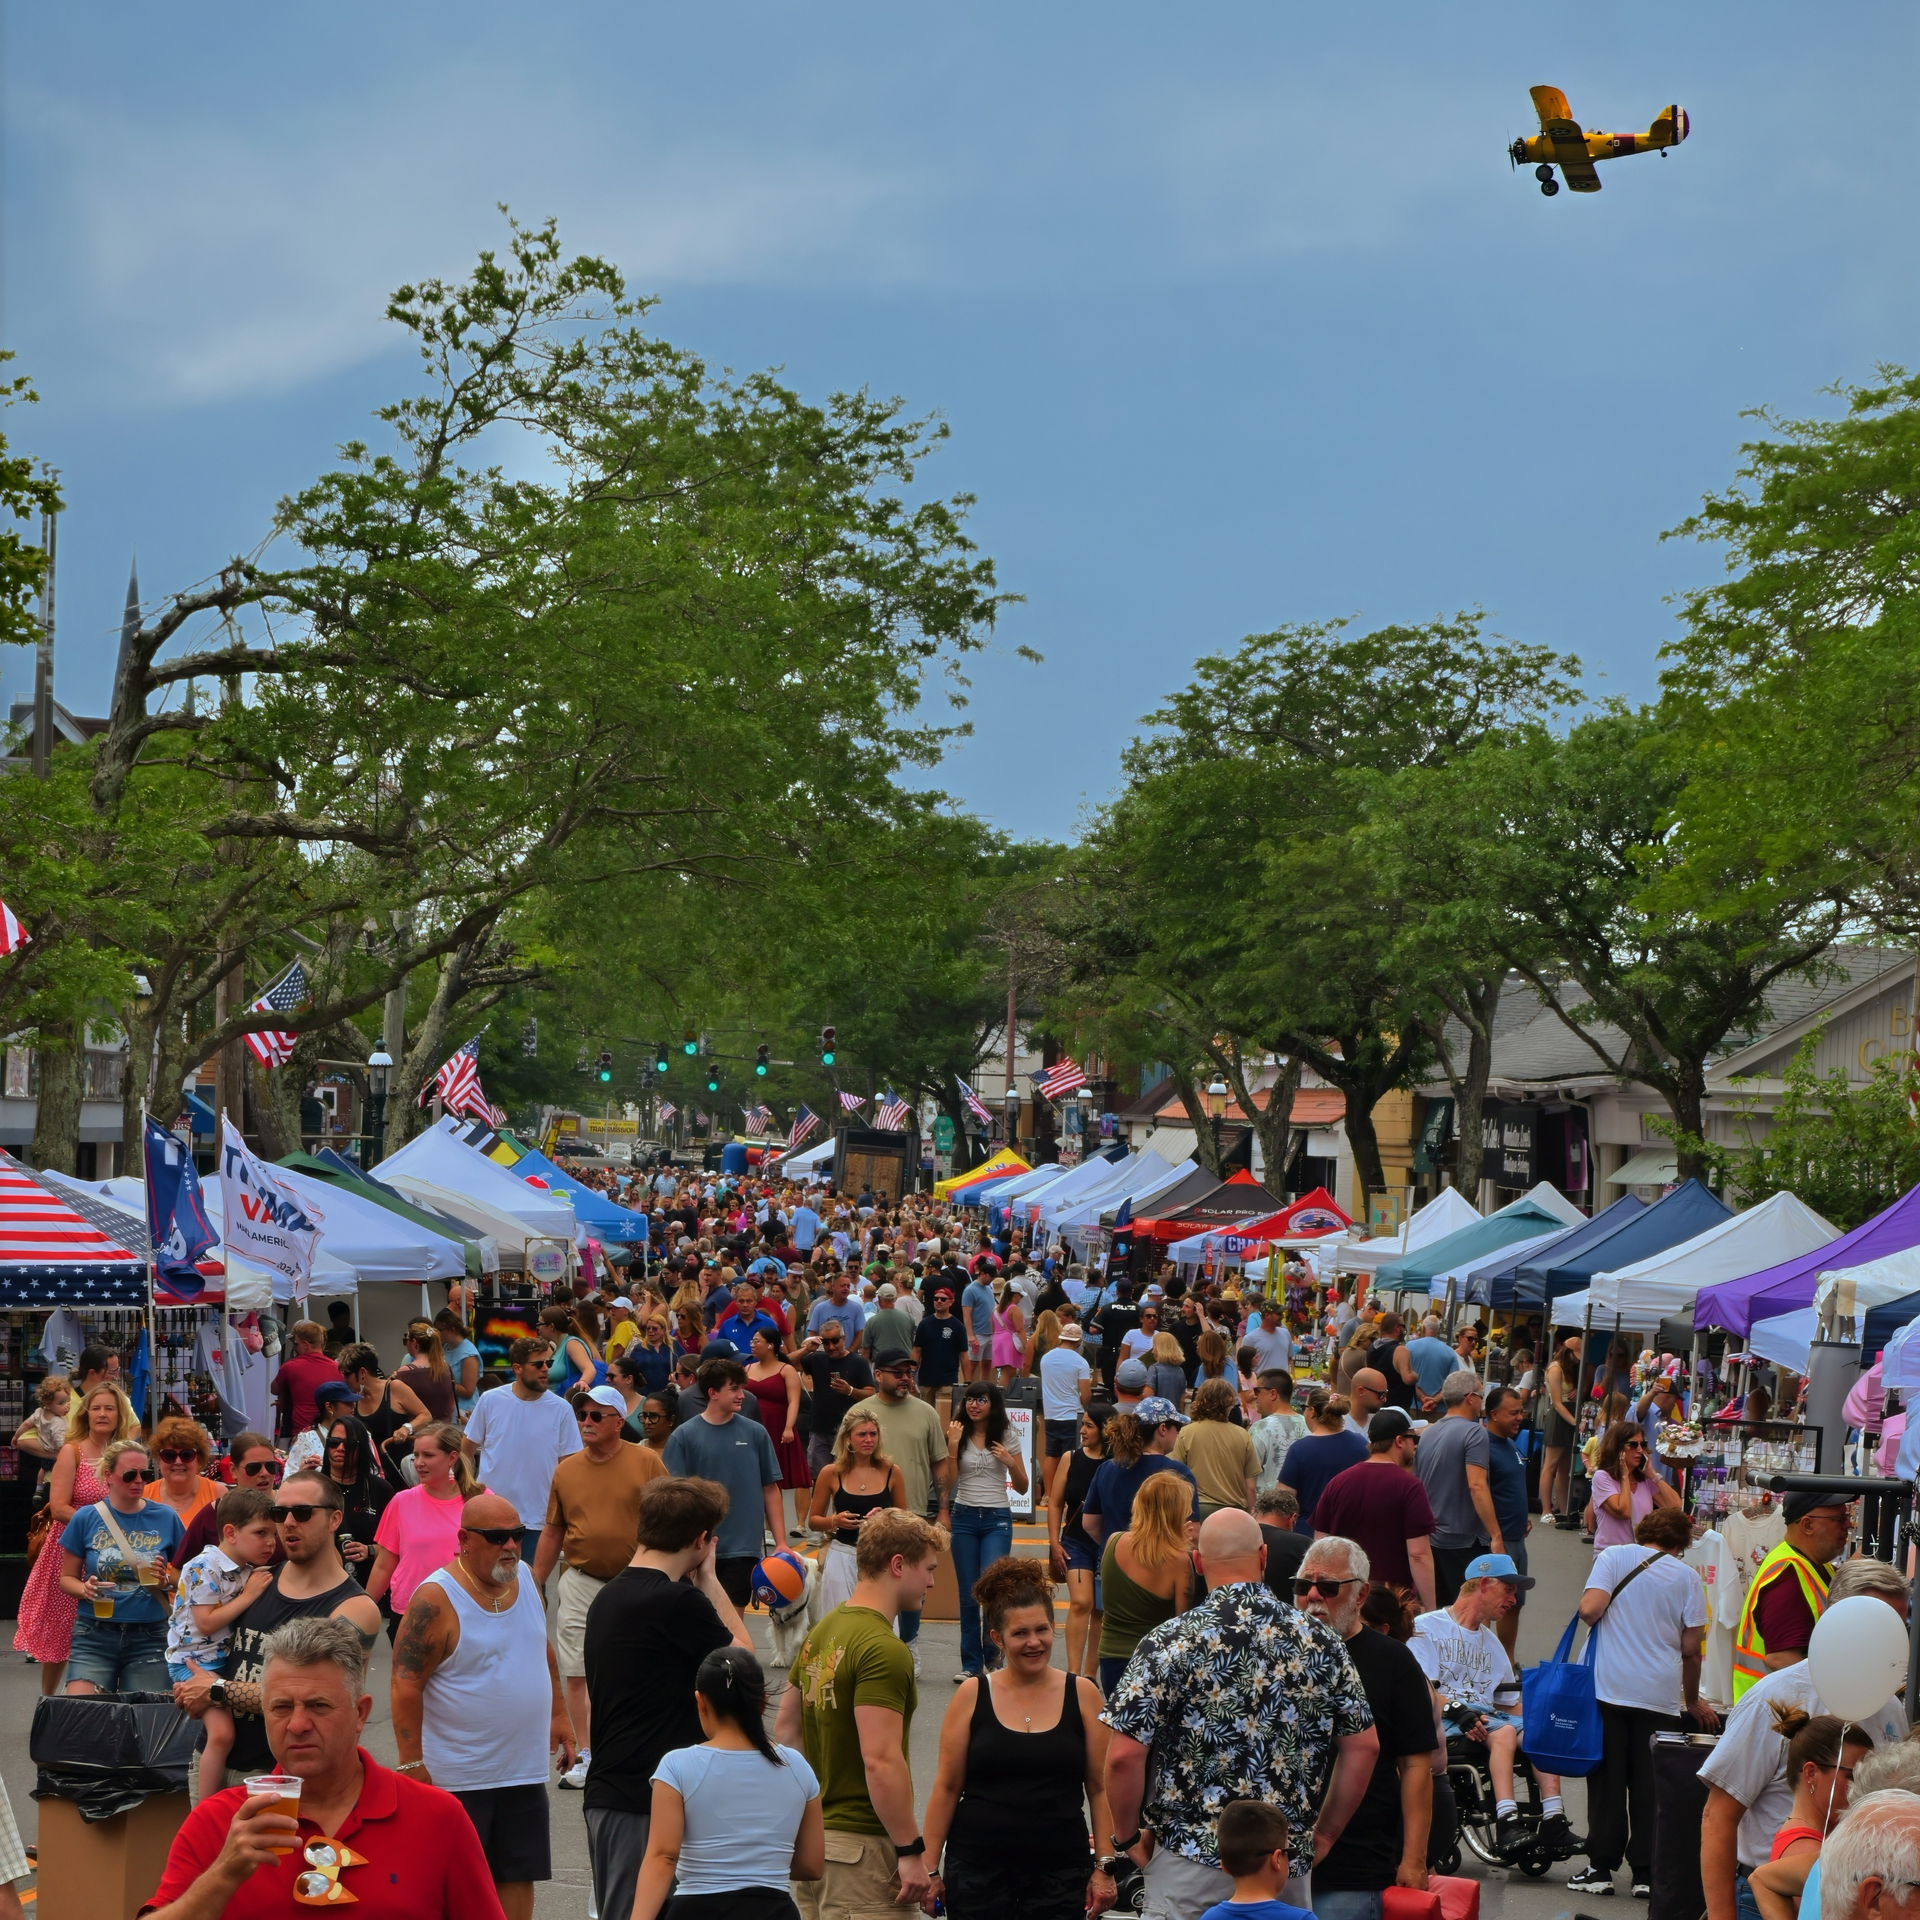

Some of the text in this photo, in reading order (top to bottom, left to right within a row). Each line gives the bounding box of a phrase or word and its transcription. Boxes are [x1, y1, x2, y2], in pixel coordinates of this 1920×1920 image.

[1176, 1222, 1208, 1230] SOLAR
[1111, 1303, 1137, 1311] POLICE
[1010, 1411, 1030, 1423] Kids
